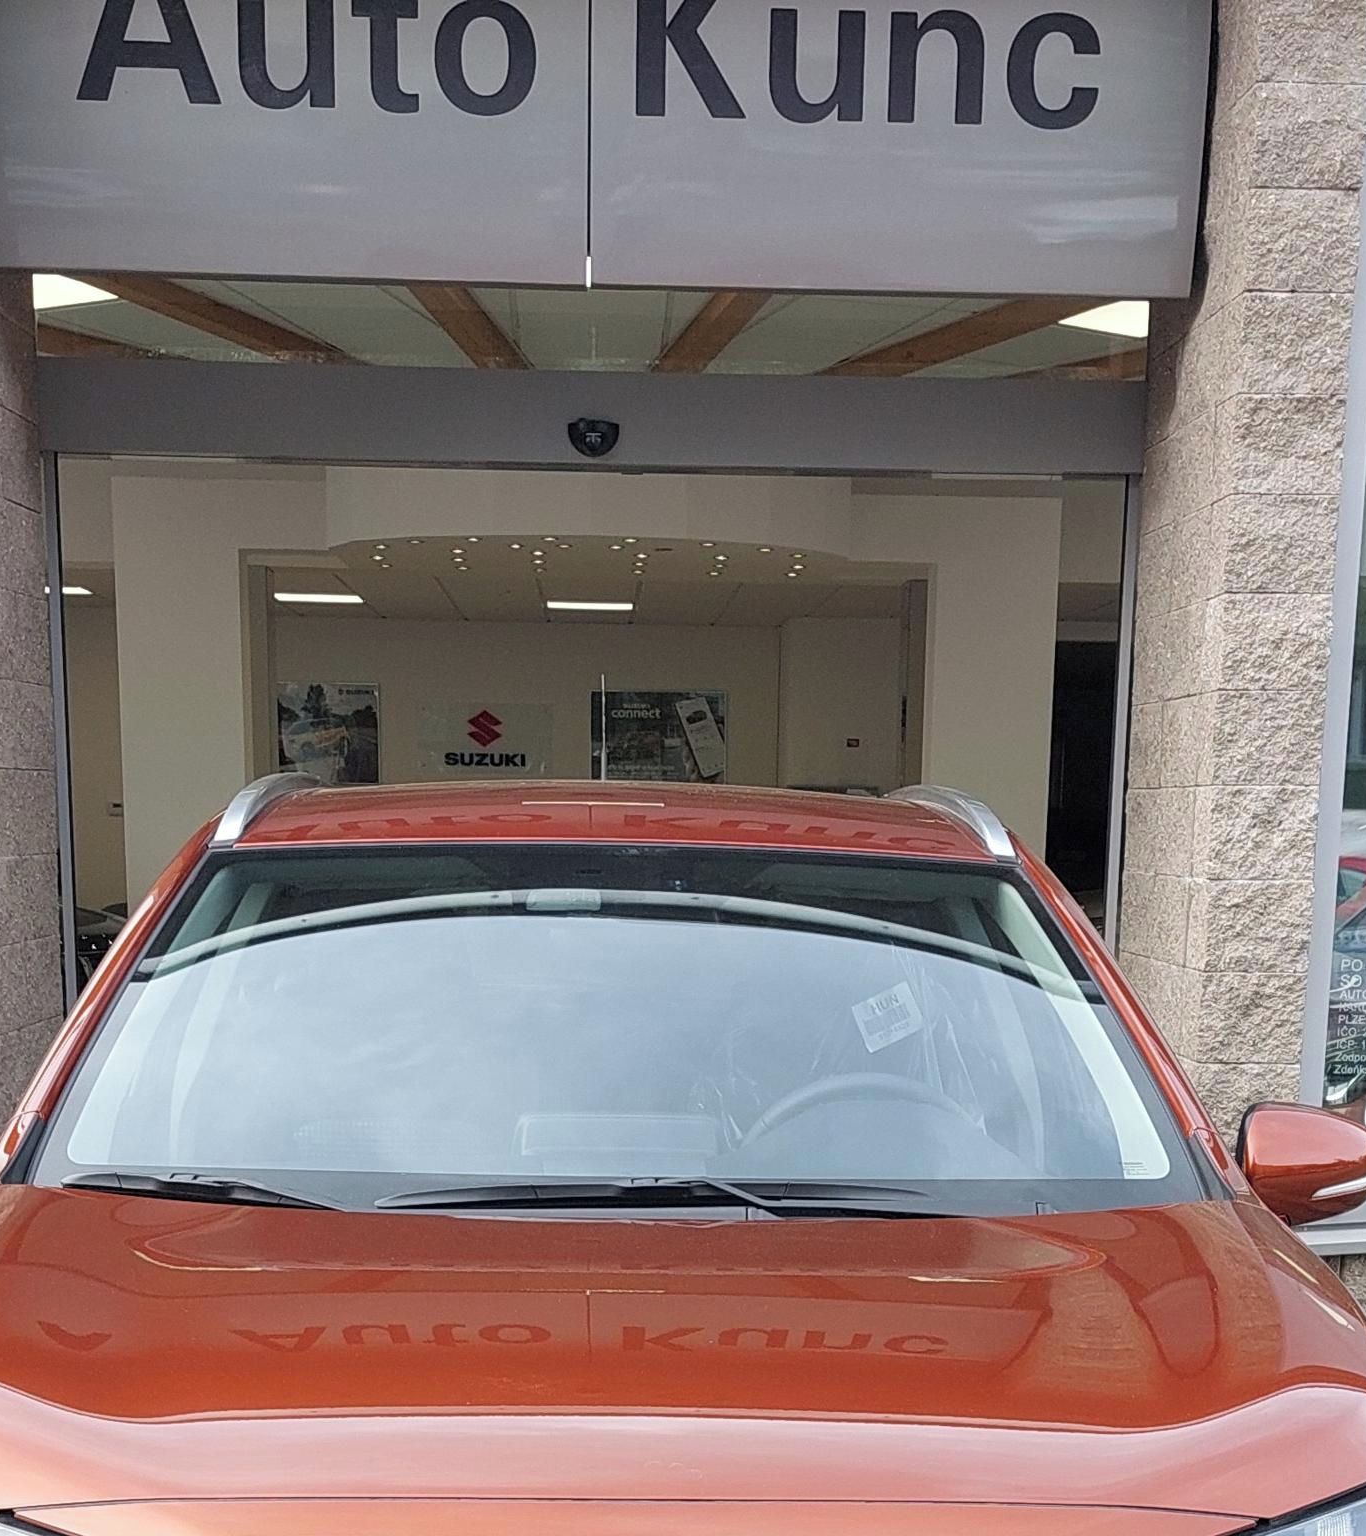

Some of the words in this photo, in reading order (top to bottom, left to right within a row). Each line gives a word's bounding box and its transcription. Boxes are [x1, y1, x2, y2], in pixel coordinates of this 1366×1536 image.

[76, 0, 537, 116] Auto
[635, 0, 1102, 130] Kunc
[611, 707, 662, 719] connect
[444, 752, 526, 767] SUZUKI
[1340, 959, 1363, 972] PO
[1340, 974, 1362, 987] SO
